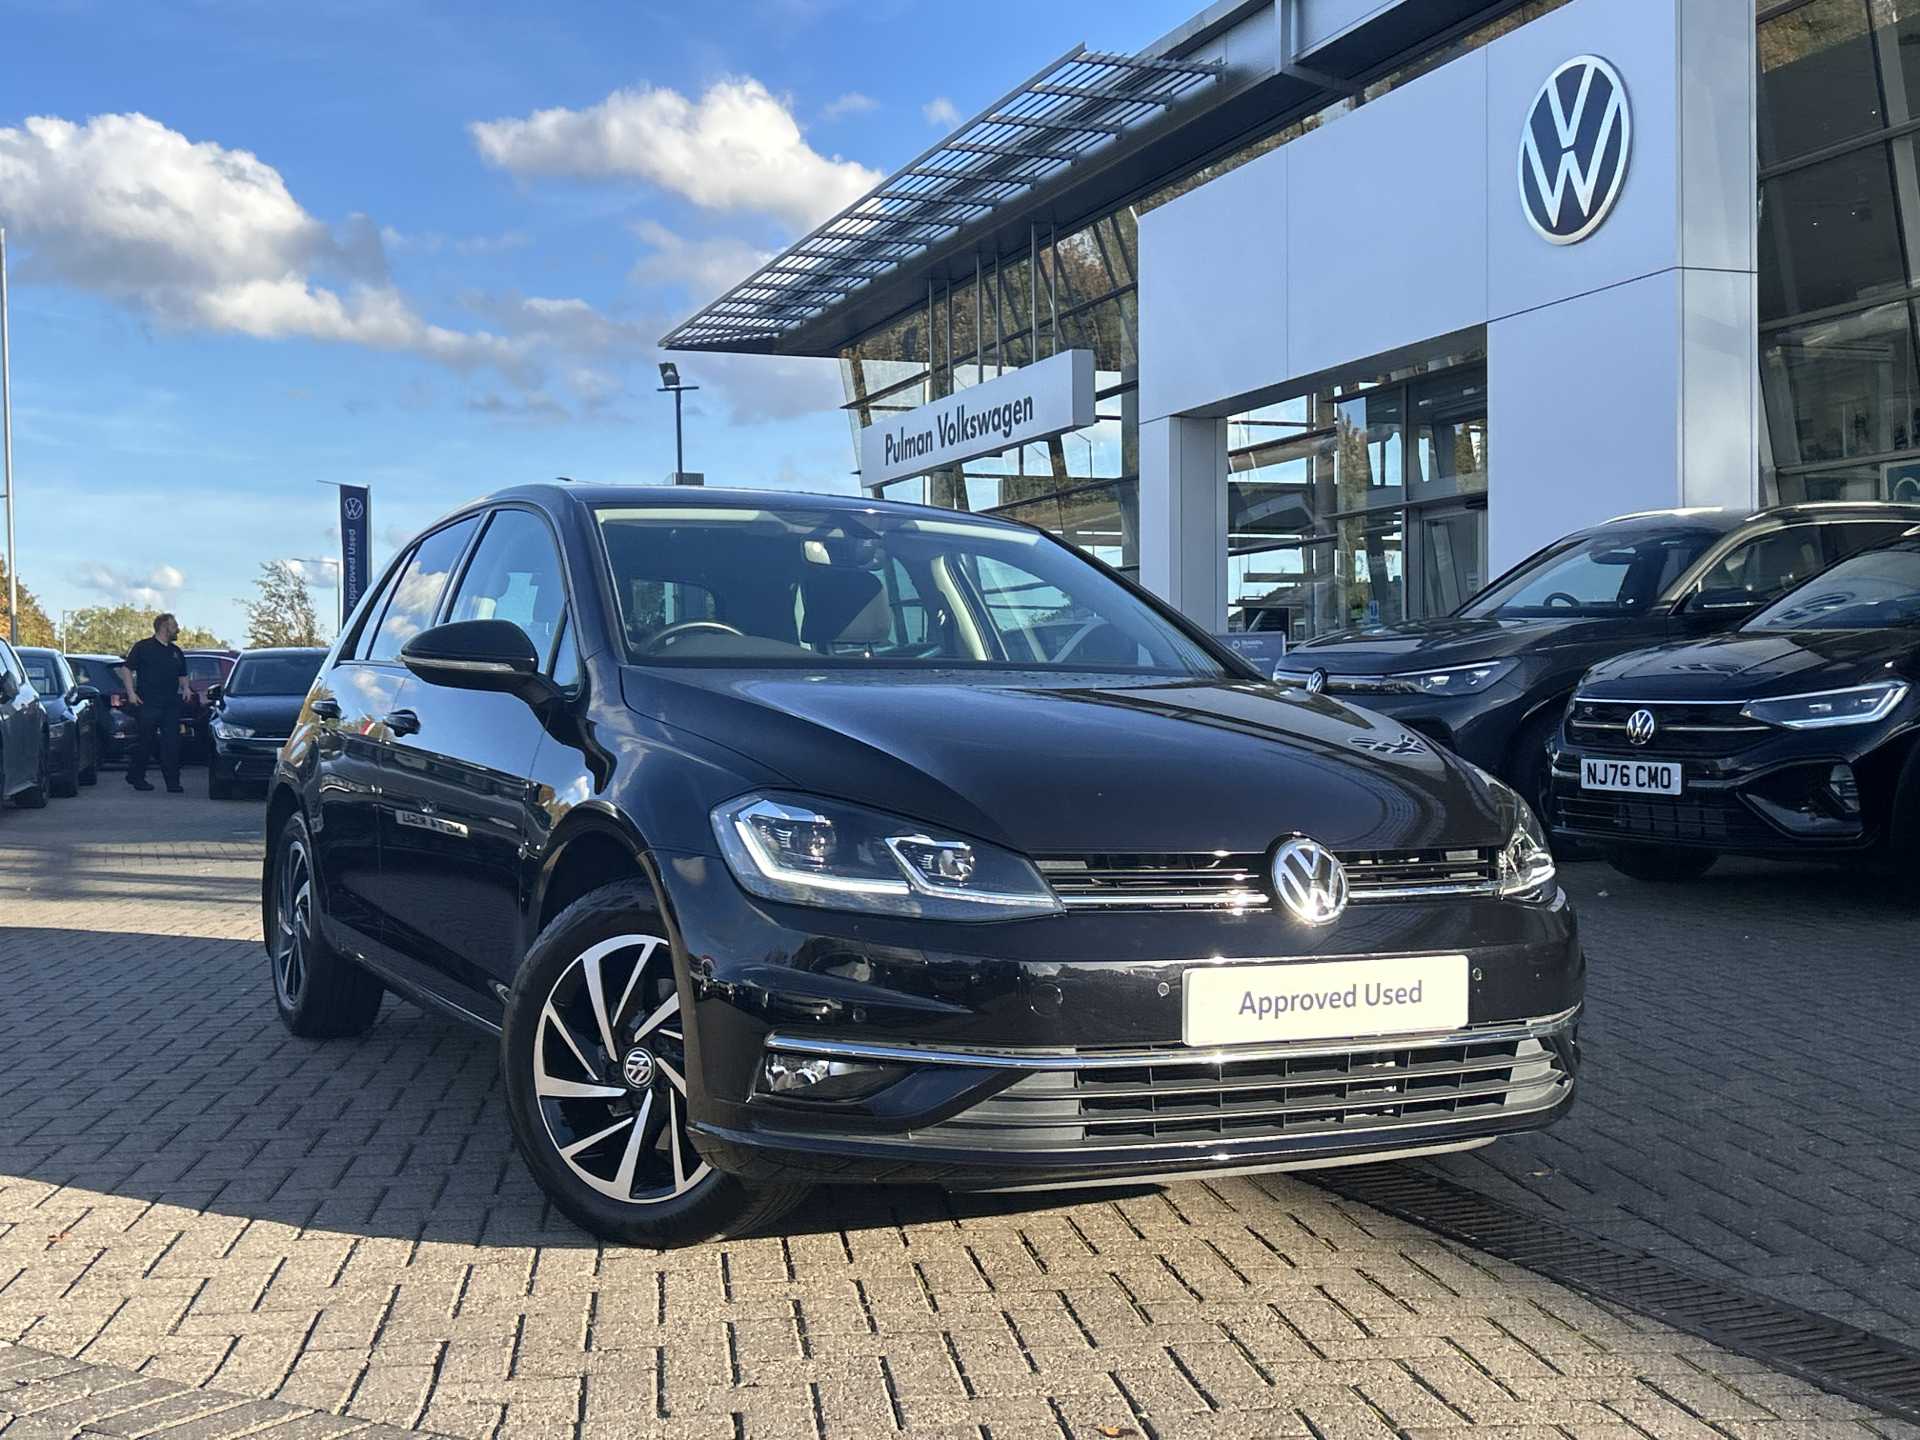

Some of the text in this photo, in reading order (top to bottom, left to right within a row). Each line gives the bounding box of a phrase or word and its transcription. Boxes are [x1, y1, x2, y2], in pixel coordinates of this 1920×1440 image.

[885, 395, 1034, 466] Pulman Volkswagen
[348, 528, 356, 555] Used
[1586, 762, 1672, 789] NJ76 CMO
[1238, 979, 1423, 1020] Approved Used
